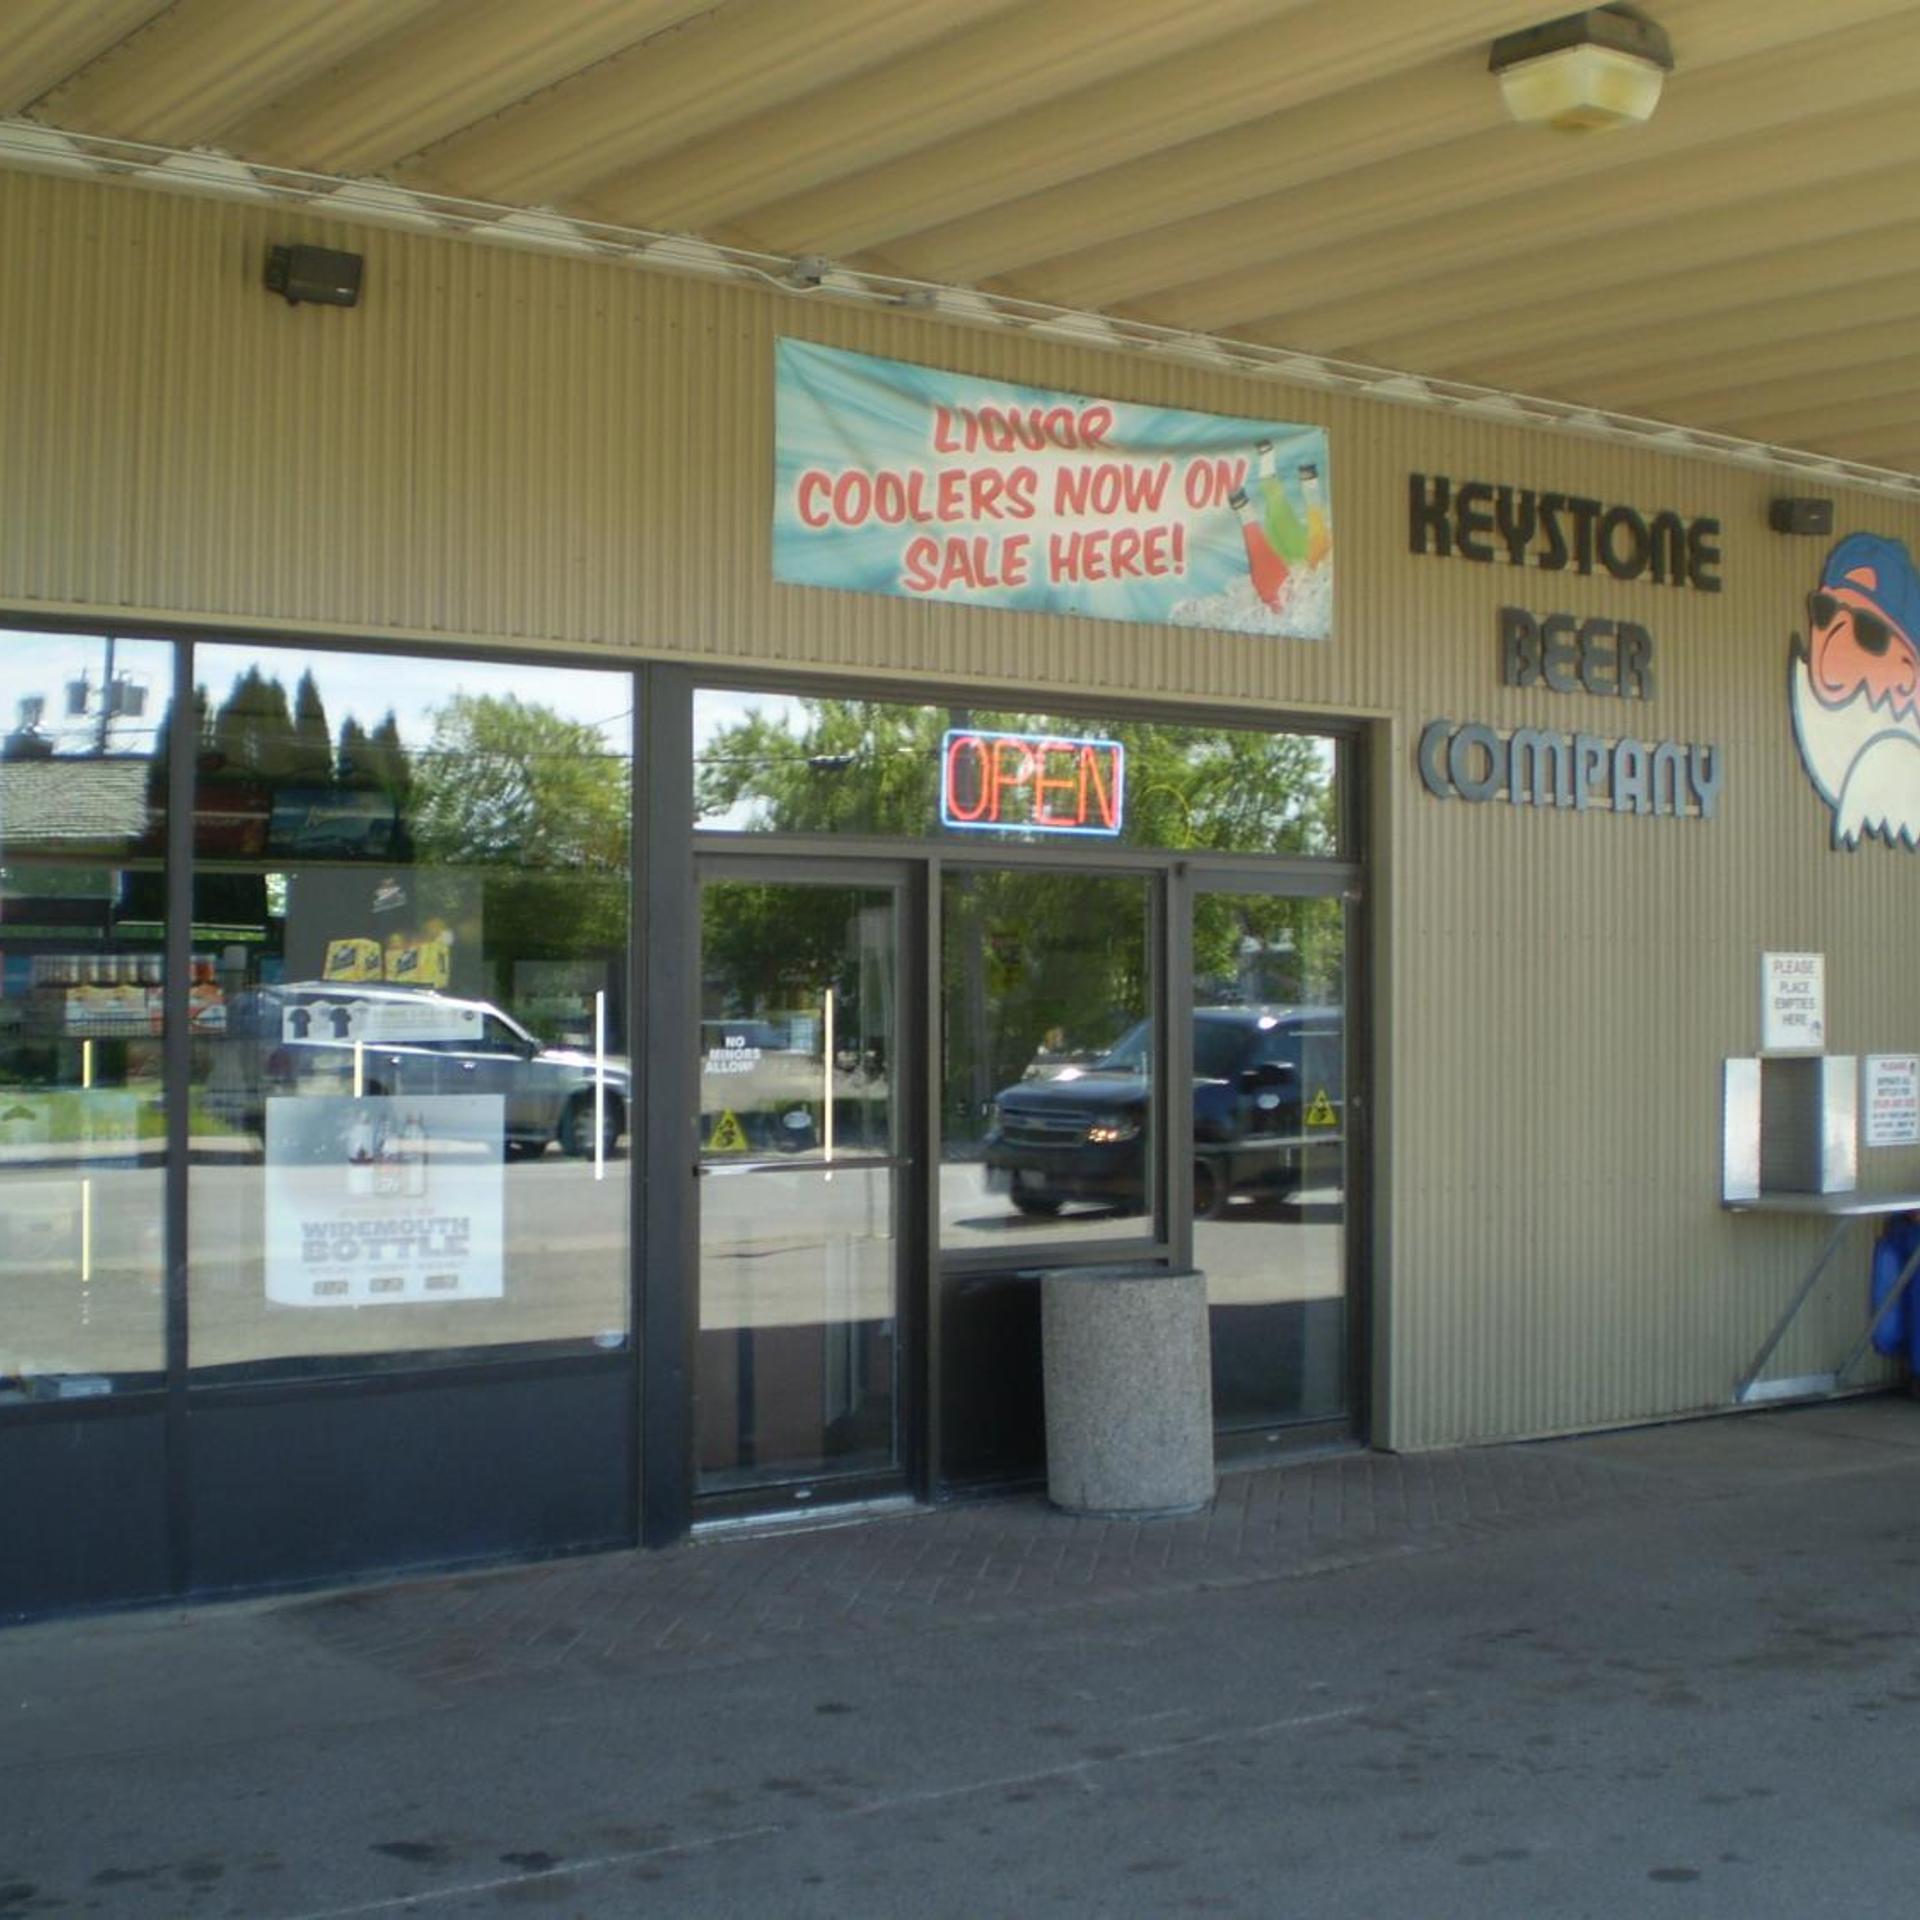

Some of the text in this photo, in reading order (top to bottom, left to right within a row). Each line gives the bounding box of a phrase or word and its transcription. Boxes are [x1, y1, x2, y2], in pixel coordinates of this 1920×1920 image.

[933, 404, 1114, 454] LIQUOR
[797, 459, 1247, 528] COOLERS NOW ON
[1408, 473, 1722, 593] KEYSTONE
[904, 524, 1185, 592] SALE HERE!
[1500, 606, 1656, 700] BEER
[947, 736, 1120, 828] OPEN
[1418, 718, 1723, 819] COMPANY
[1773, 959, 1816, 975] PLEASE
[1779, 980, 1811, 994] PLACE
[1774, 997, 1816, 1010] EMPTIES
[1782, 1013, 1808, 1026] HERE
[708, 1048, 762, 1060] MINORS
[725, 1036, 746, 1048] NO
[301, 1216, 470, 1239] WIDEMOUTH
[301, 1235, 470, 1263] BOTTLE
